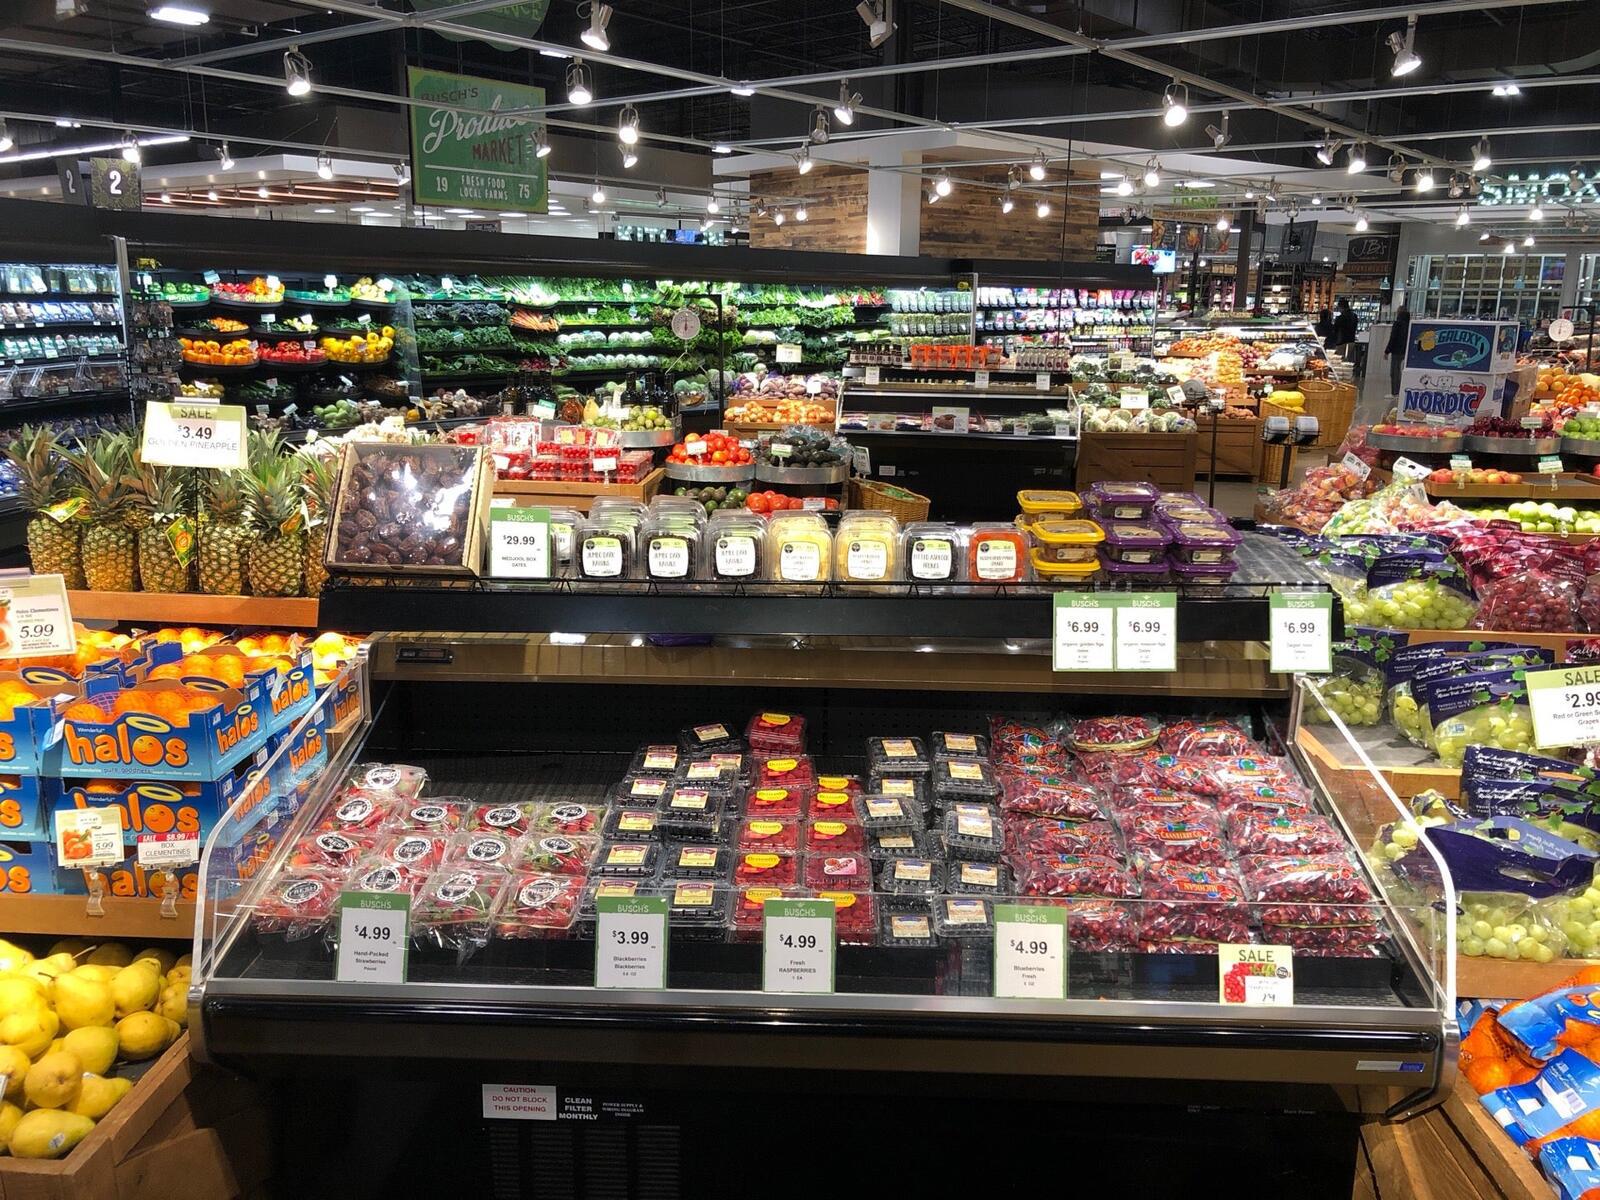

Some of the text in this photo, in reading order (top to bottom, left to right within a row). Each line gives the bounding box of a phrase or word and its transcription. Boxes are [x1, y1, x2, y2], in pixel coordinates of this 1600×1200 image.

[472, 134, 524, 165] MARKET
[66, 169, 76, 194] 2
[109, 170, 122, 194] 2
[436, 176, 449, 193] 19
[461, 175, 506, 189] FRESH FOOD
[459, 188, 508, 200] LOCAL FARMS
[519, 184, 530, 199] 75
[1438, 330, 1482, 347] GALAXY
[1403, 390, 1478, 417] NORDIC
[180, 408, 213, 419] SALE
[177, 425, 213, 440] $3.49
[190, 441, 238, 451] PINEAPPLE
[503, 535, 536, 545] $29.99
[1071, 600, 1099, 608] BUSCH'S
[1132, 600, 1160, 608] BUSCH'S
[20, 624, 54, 639] 5.99
[1067, 621, 1099, 633] $6.99
[1128, 621, 1161, 633] $6.99
[1283, 622, 1315, 634] $6.99
[271, 678, 309, 716] halos
[1574, 710, 1593, 718] Green
[216, 711, 258, 755] halos
[65, 723, 189, 768] halos
[289, 734, 322, 774] halos
[95, 842, 114, 851] 5.99
[145, 848, 191, 857] CLEMENTINES
[474, 846, 500, 854] FRESH
[360, 900, 392, 909] BUSCH'S
[617, 904, 649, 913] BUSCH'S
[784, 908, 816, 917] BUSCH'S
[1015, 913, 1047, 923] BUSCH'S
[354, 925, 391, 940] $4.99
[612, 930, 649, 944] $3.99
[779, 934, 816, 948] $4.99
[1010, 940, 1048, 955] $4.99
[1238, 949, 1275, 962] SALE
[564, 1097, 592, 1105] CLEAN
